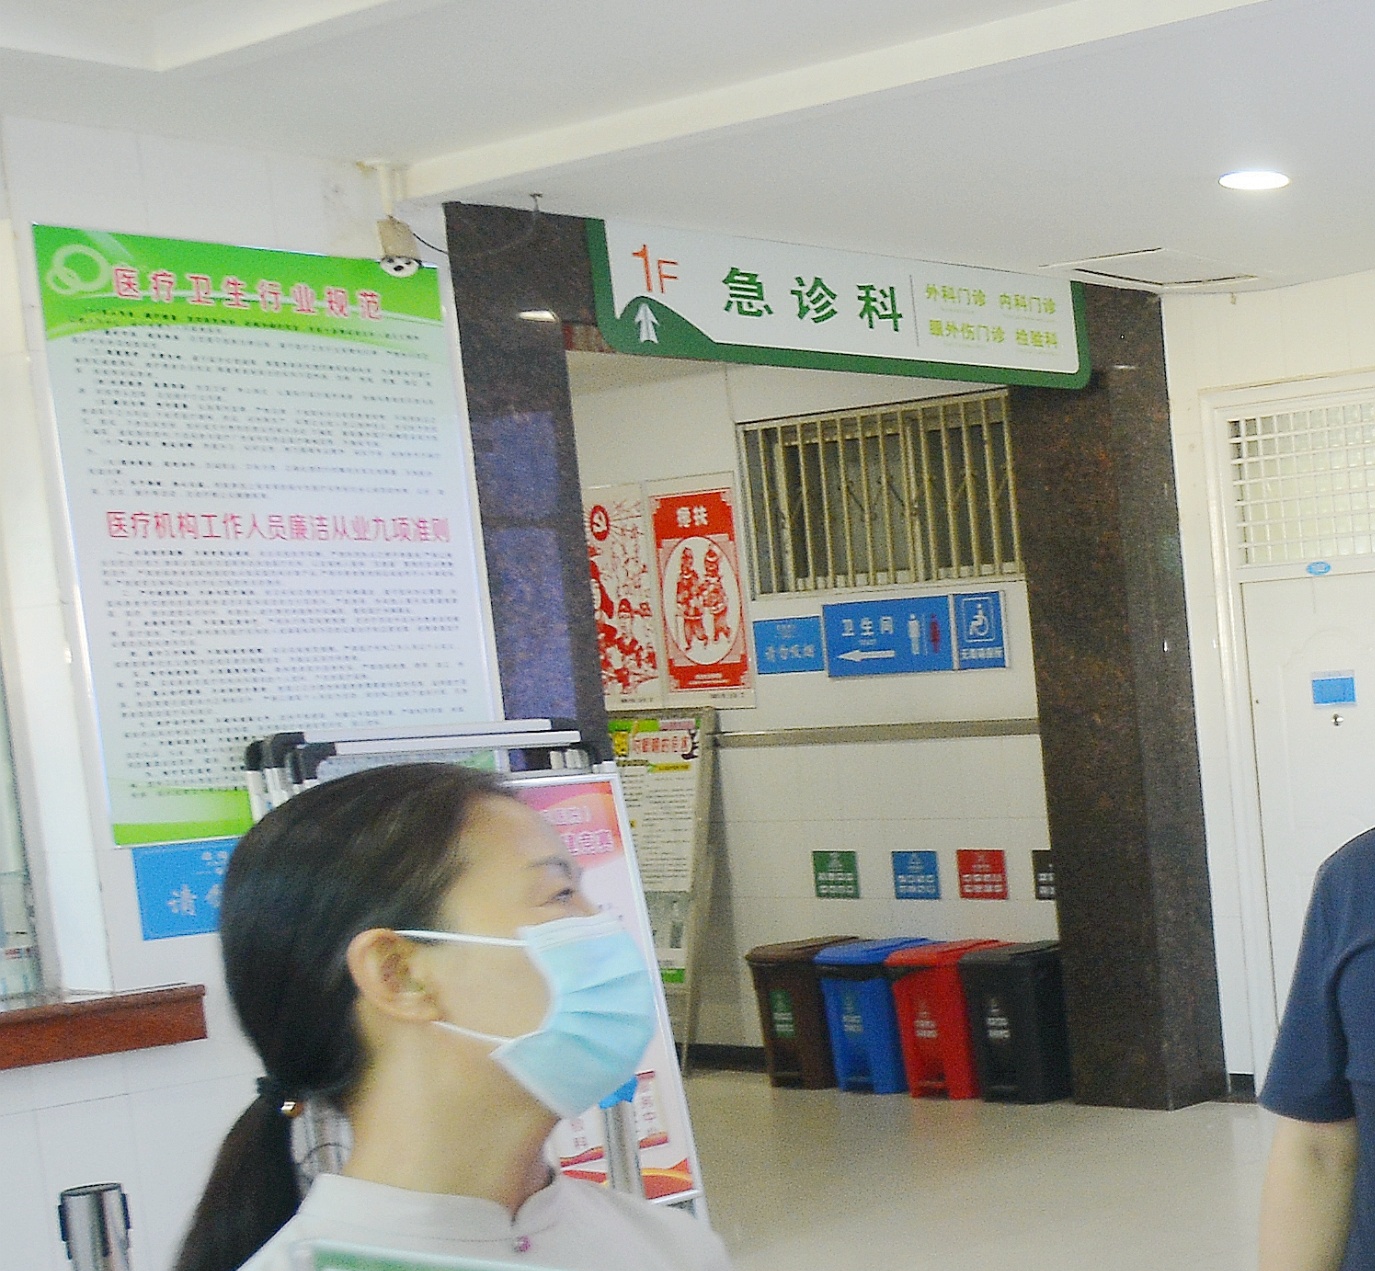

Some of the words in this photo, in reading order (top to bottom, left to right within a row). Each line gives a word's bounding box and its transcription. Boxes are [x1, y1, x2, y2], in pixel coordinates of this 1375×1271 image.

[113, 266, 384, 322] 医疗卫生行业规范
[631, 243, 679, 295] 1F
[721, 265, 903, 332] 急诊科
[106, 510, 452, 544] 医疗机构工作人员廉洁从业九项准则
[842, 615, 895, 637] 卫生间
